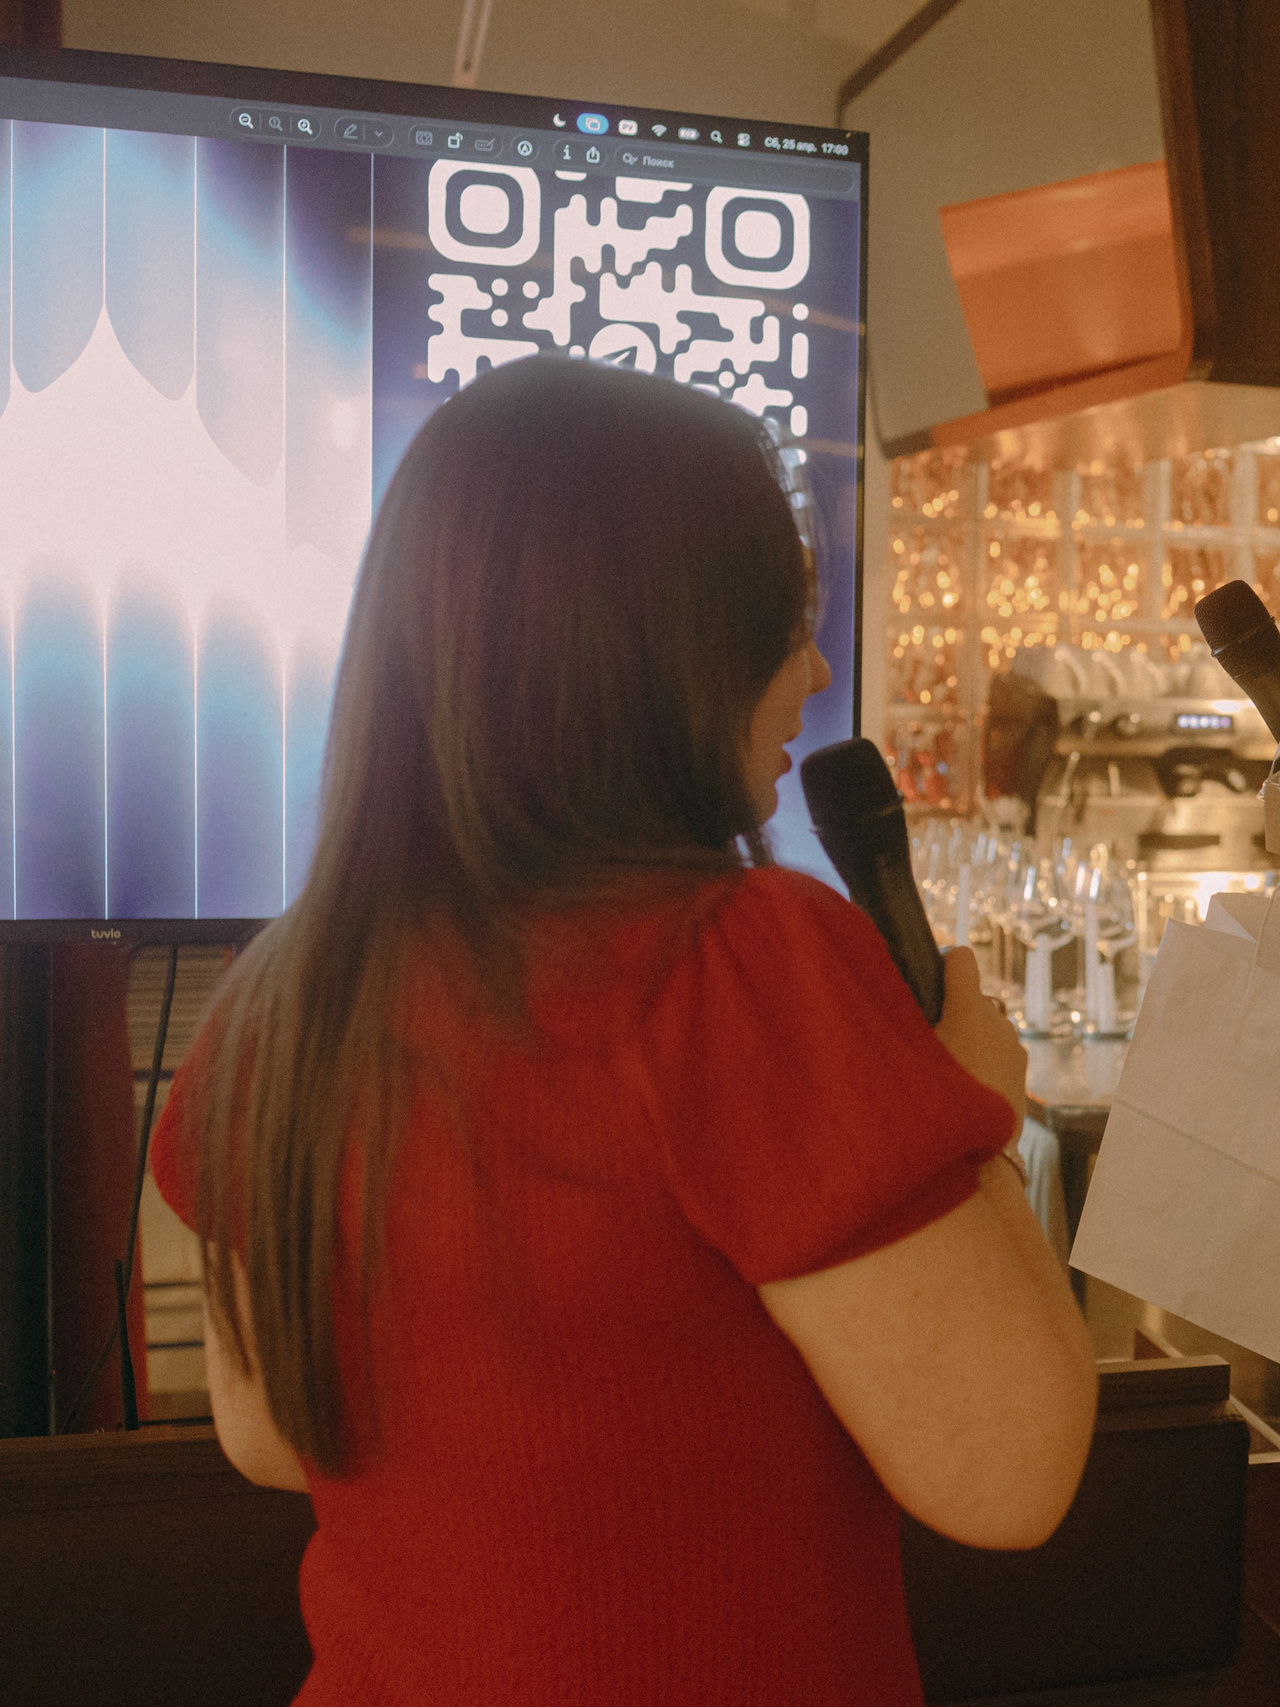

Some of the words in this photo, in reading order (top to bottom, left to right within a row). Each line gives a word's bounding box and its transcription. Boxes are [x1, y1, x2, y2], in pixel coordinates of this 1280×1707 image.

[764, 136, 781, 150] Сб,
[782, 138, 796, 150] 25
[642, 155, 675, 169] Поиск
